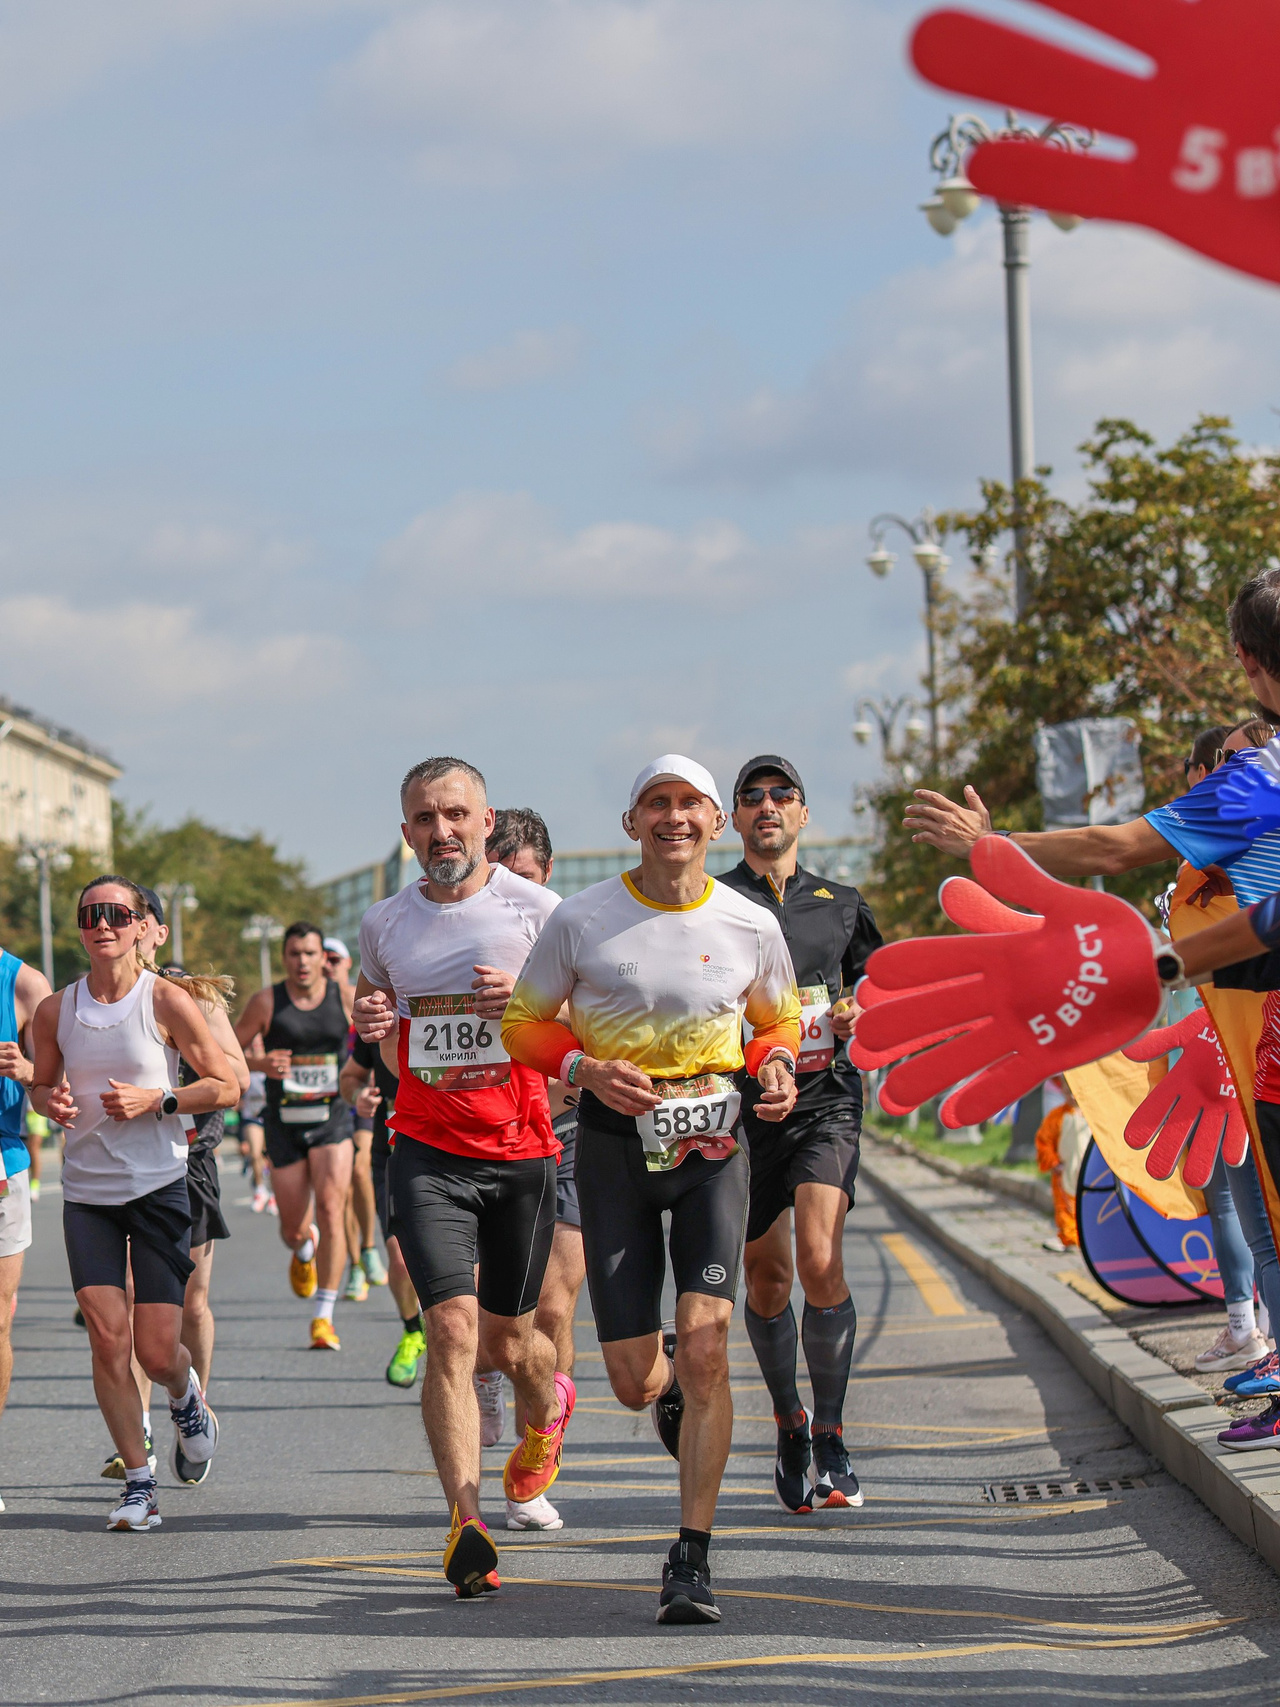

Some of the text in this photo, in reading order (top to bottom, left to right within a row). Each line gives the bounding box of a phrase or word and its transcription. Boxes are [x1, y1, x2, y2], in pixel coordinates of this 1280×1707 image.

[1172, 124, 1226, 194] 5
[1028, 923, 1109, 1046] 5 вёрст
[423, 1020, 493, 1051] 2186
[439, 1052, 477, 1062] КИРИЛЛ
[420, 1070, 432, 1084] D
[1219, 1083, 1238, 1099] 5
[653, 1100, 728, 1137] 5837
